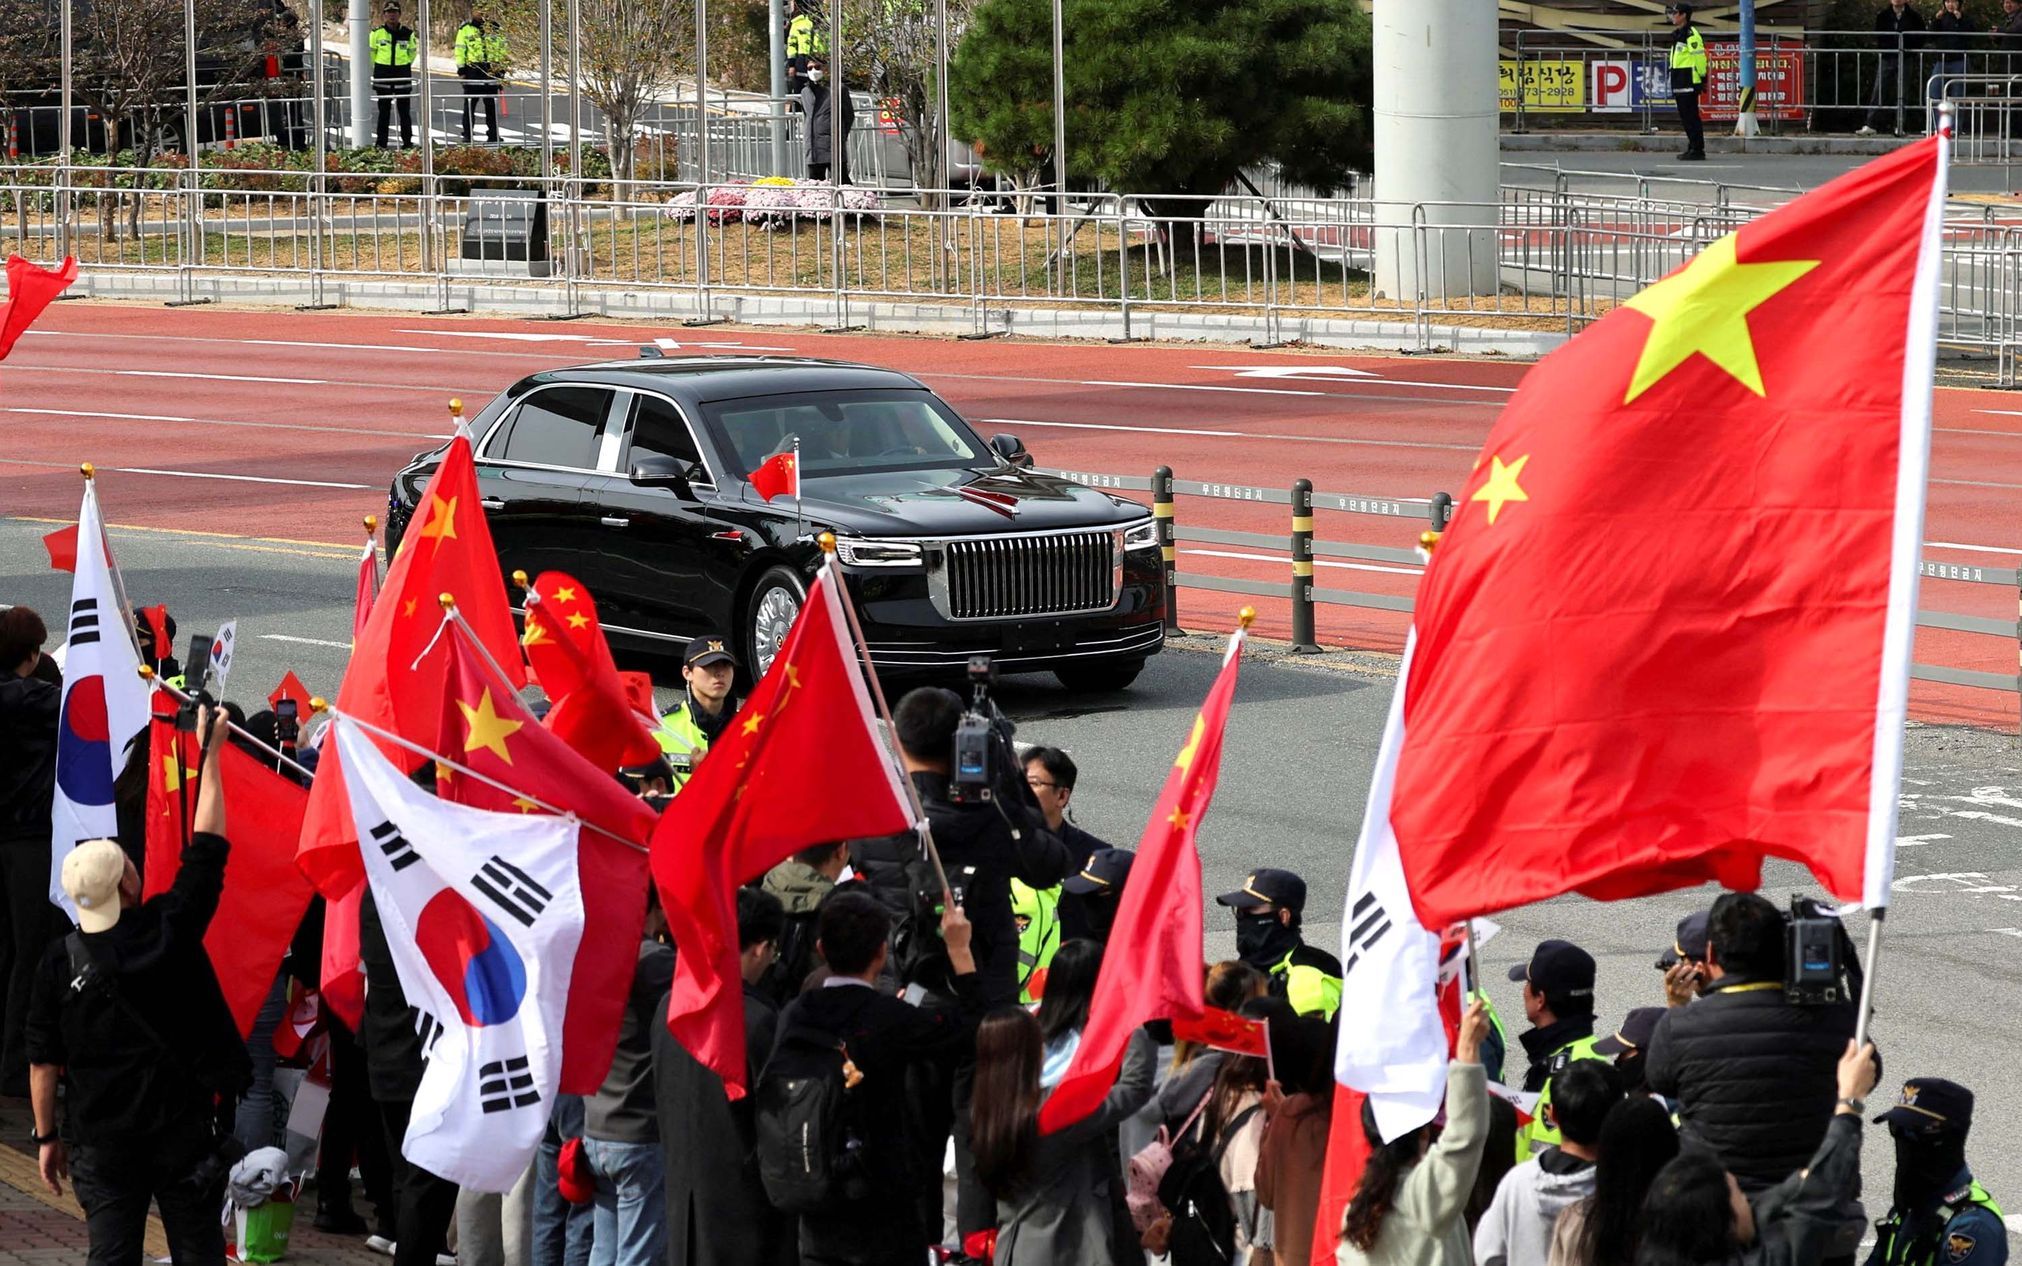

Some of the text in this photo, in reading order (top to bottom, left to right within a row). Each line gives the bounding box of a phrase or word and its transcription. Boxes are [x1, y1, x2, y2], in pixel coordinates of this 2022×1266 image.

[1597, 65, 1627, 107] P
[1202, 483, 1263, 501] 무단횡단금지
[1339, 498, 1400, 516] 무단횡단금지
